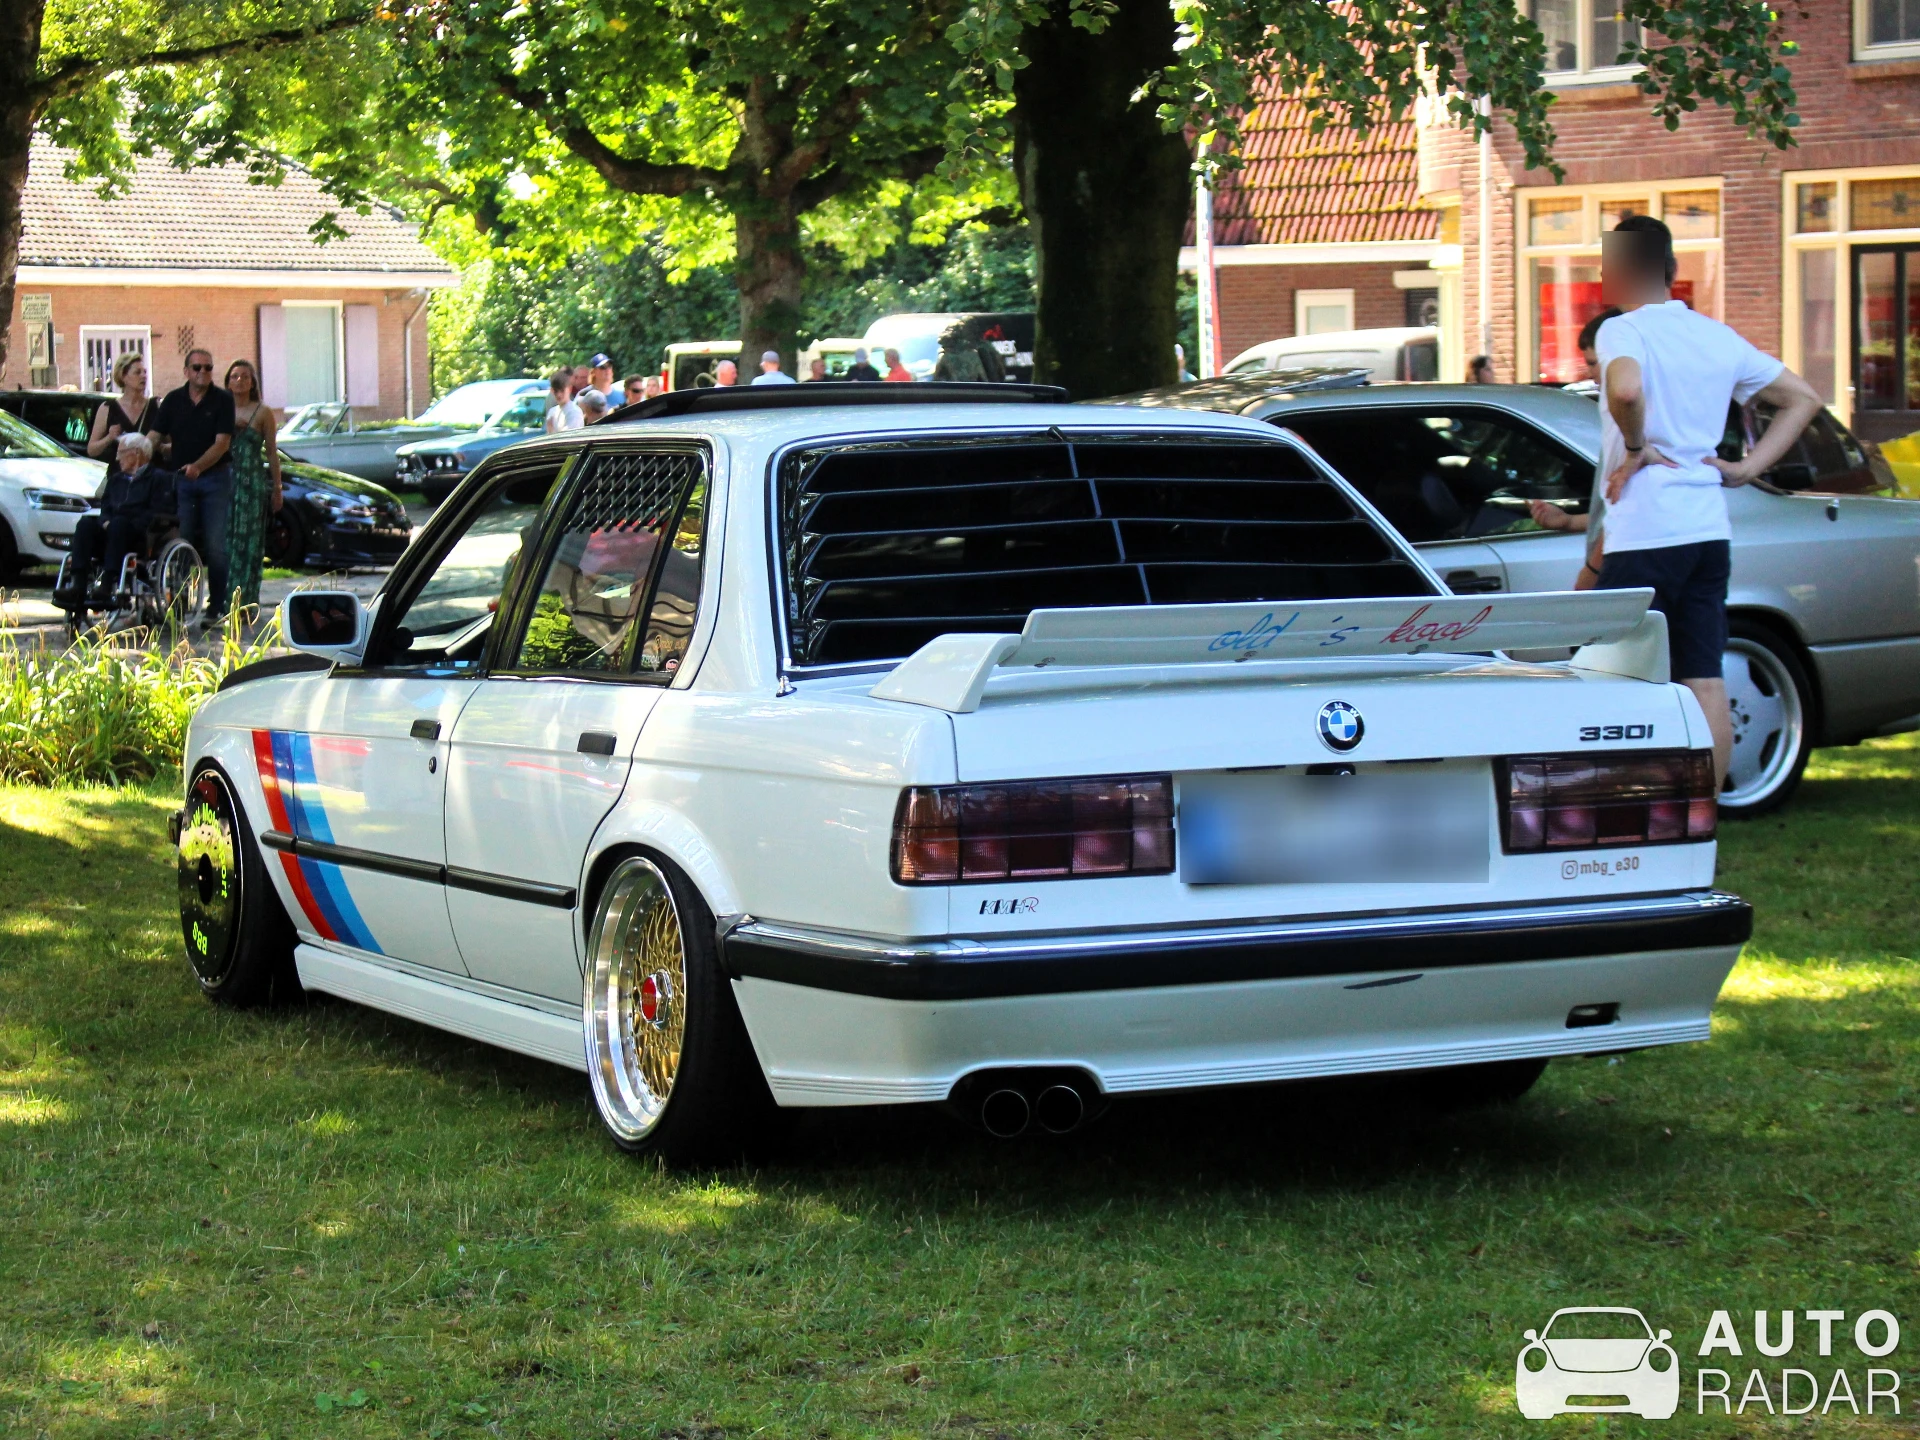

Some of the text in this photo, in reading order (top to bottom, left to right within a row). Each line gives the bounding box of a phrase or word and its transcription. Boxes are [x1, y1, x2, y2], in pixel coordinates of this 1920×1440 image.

[1208, 612, 1300, 652] old
[1379, 603, 1493, 645] kool
[1321, 702, 1360, 719] BMW
[1580, 856, 1640, 876] mbg_e30
[192, 921, 208, 956] BBS
